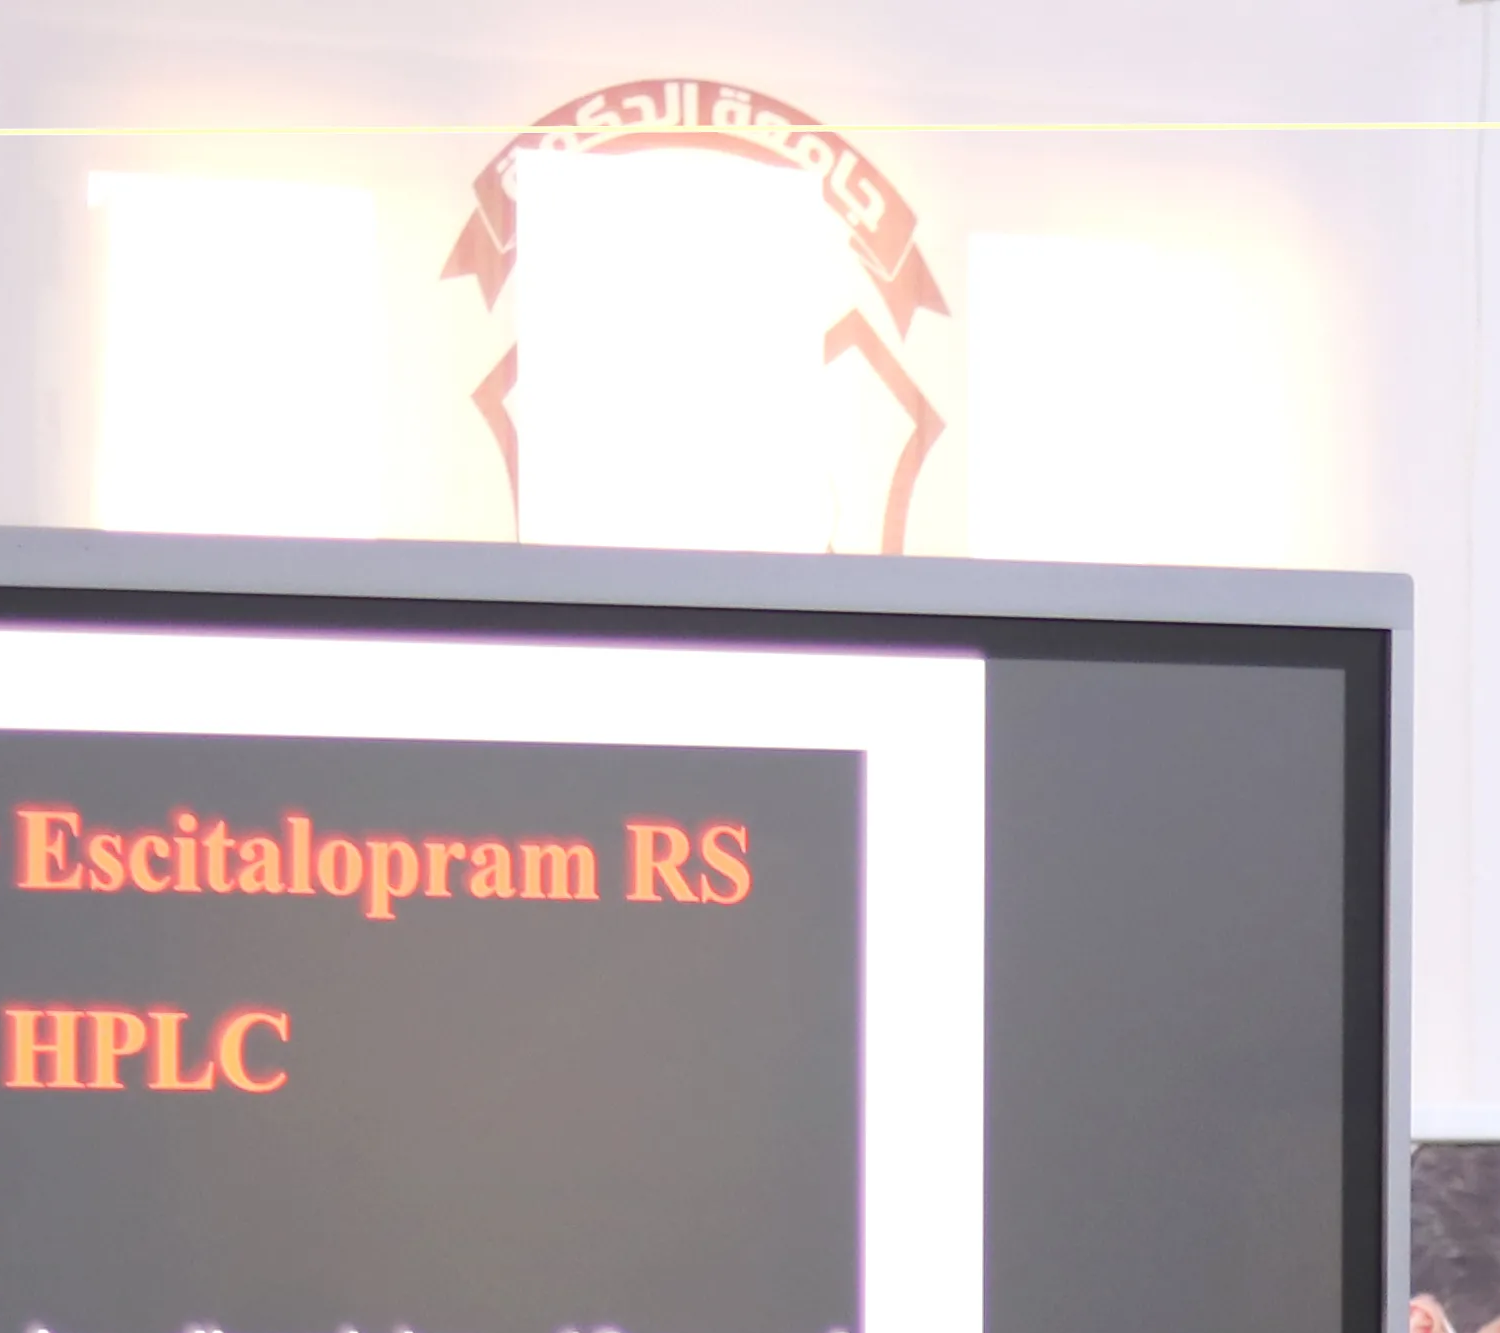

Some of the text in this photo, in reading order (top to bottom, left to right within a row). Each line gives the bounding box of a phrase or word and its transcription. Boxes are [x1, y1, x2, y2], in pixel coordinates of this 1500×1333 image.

[16, 805, 599, 919] Escitalopram
[625, 820, 751, 904] RS
[3, 1005, 289, 1092] HPLC
